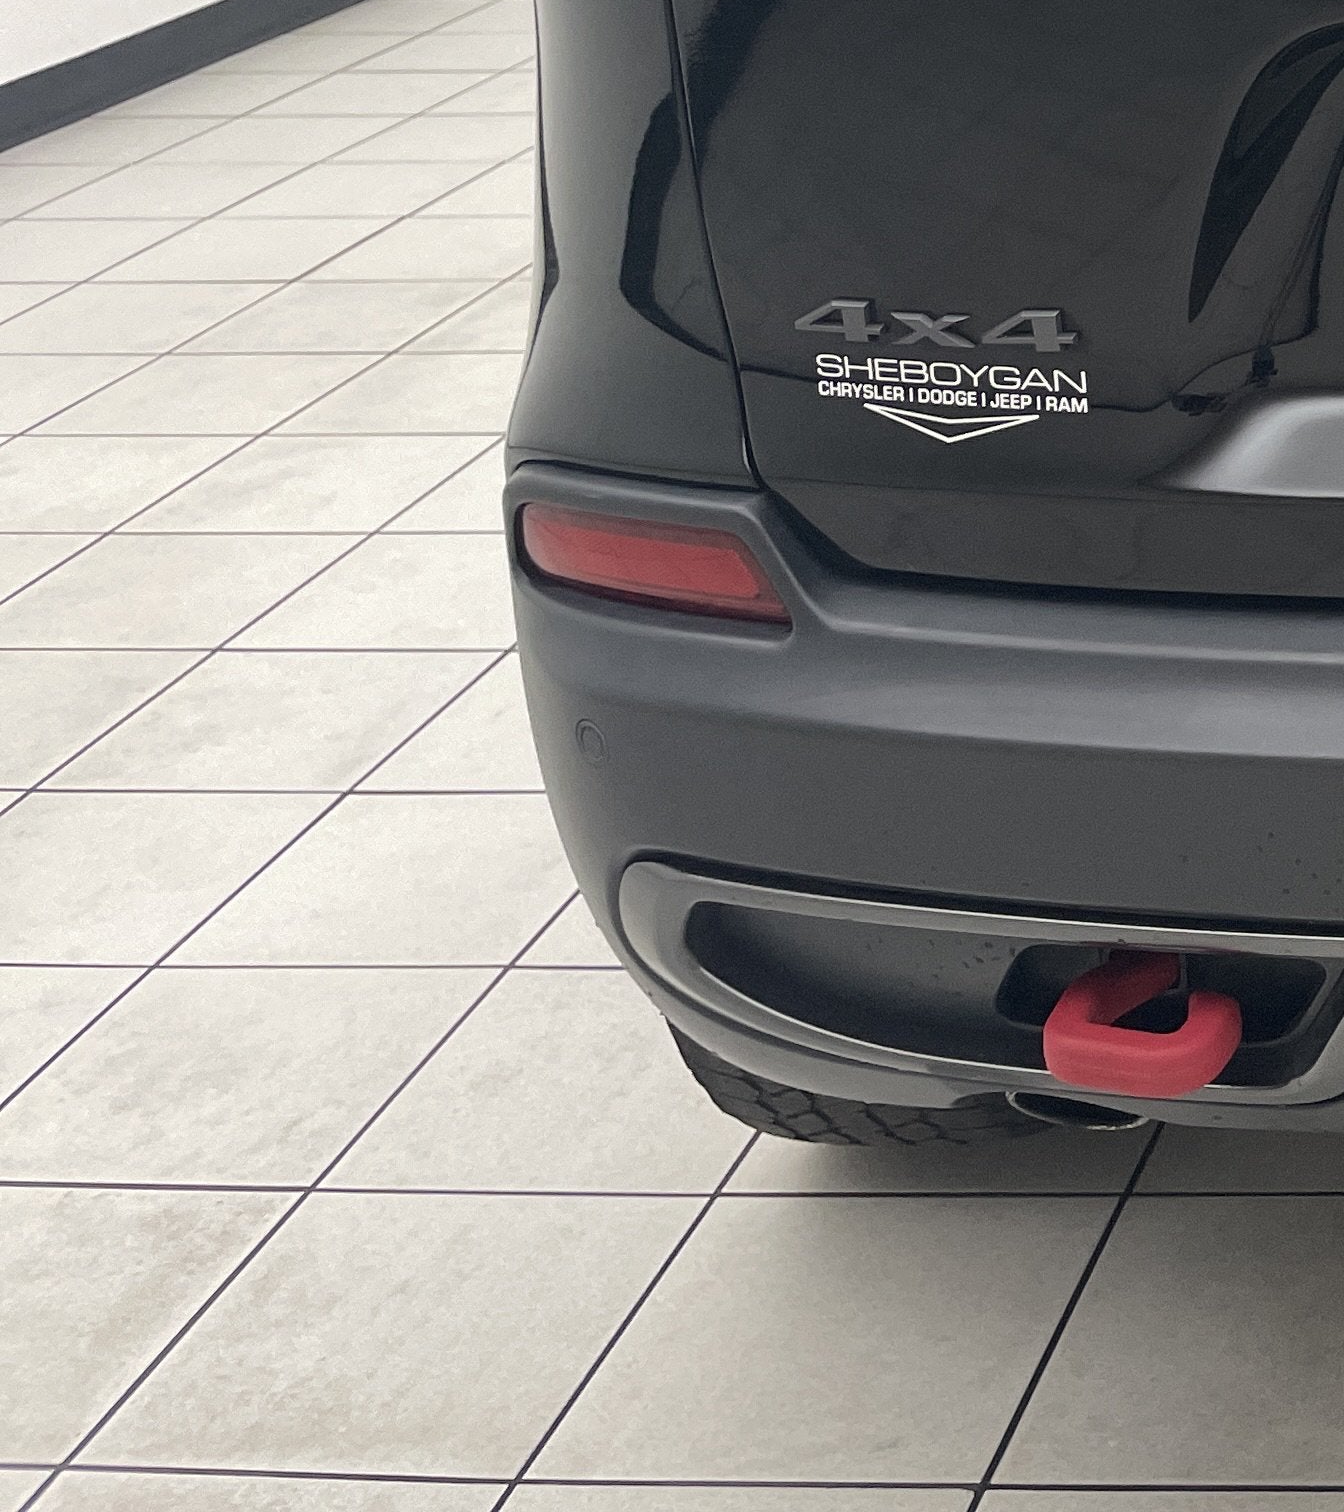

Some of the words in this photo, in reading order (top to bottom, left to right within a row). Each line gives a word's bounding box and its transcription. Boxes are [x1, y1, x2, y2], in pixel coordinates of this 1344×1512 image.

[794, 300, 1078, 352] 4x4
[816, 353, 1088, 395] SHEBOYGAN
[817, 380, 905, 402] CHRYSLER
[921, 387, 978, 407] DODGE
[990, 392, 1033, 410] JEEP
[1045, 396, 1089, 414] RAM
